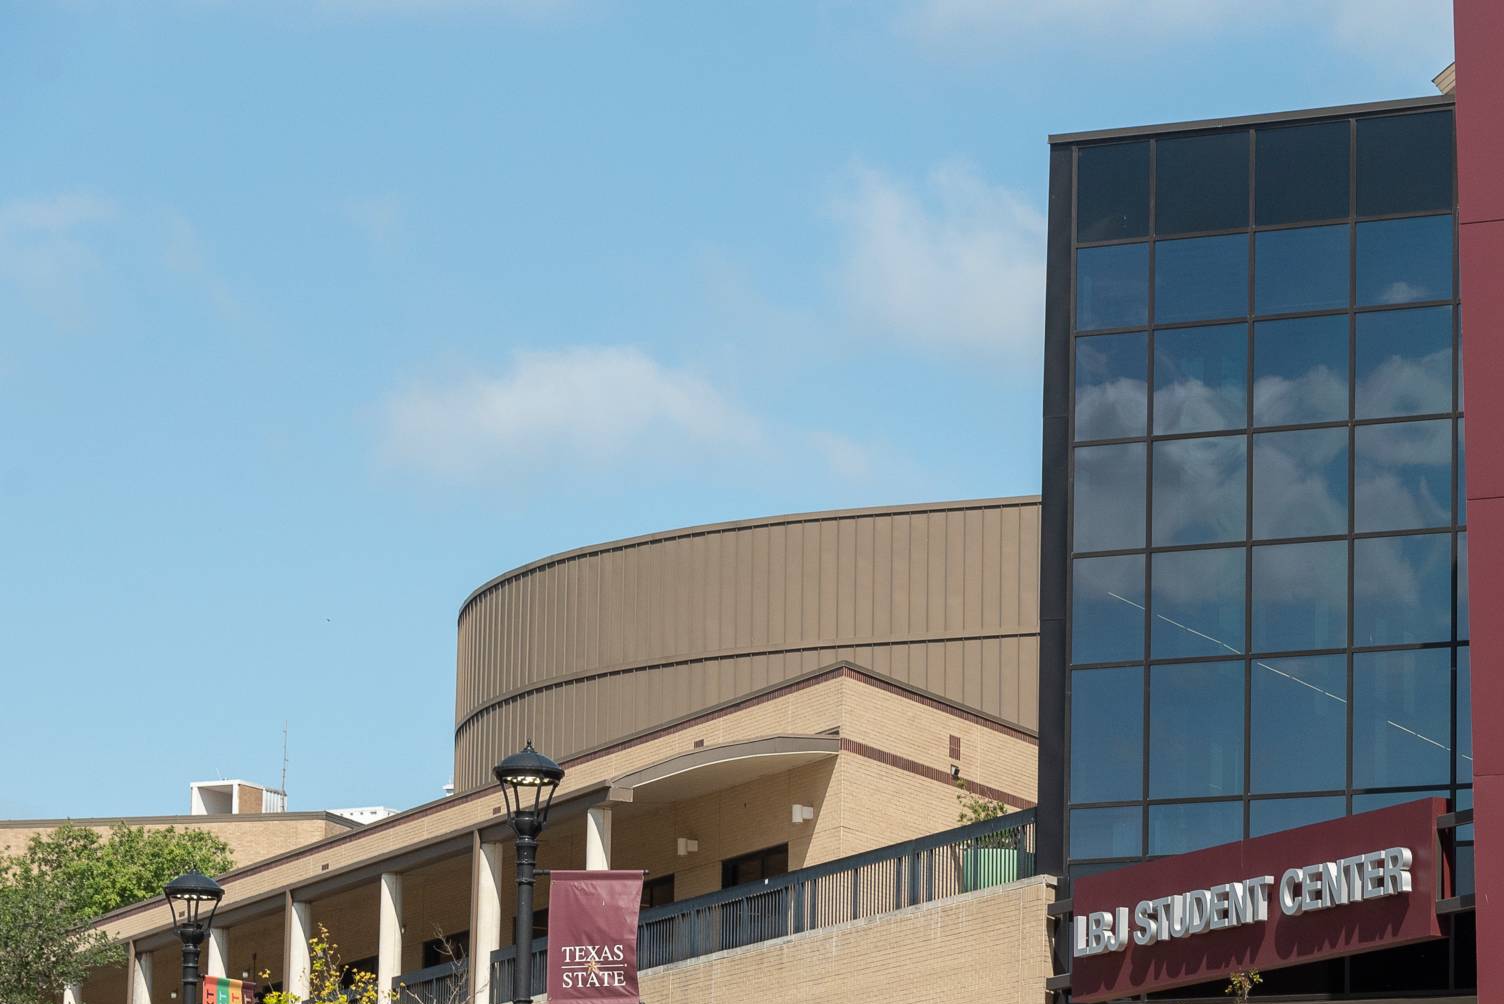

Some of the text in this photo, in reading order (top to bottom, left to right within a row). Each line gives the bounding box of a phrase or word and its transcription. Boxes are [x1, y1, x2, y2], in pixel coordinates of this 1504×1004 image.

[1073, 846, 1413, 958] LBJ STUDENT CENTER
[561, 944, 624, 962] TEXAS
[562, 970, 626, 988] STATE
